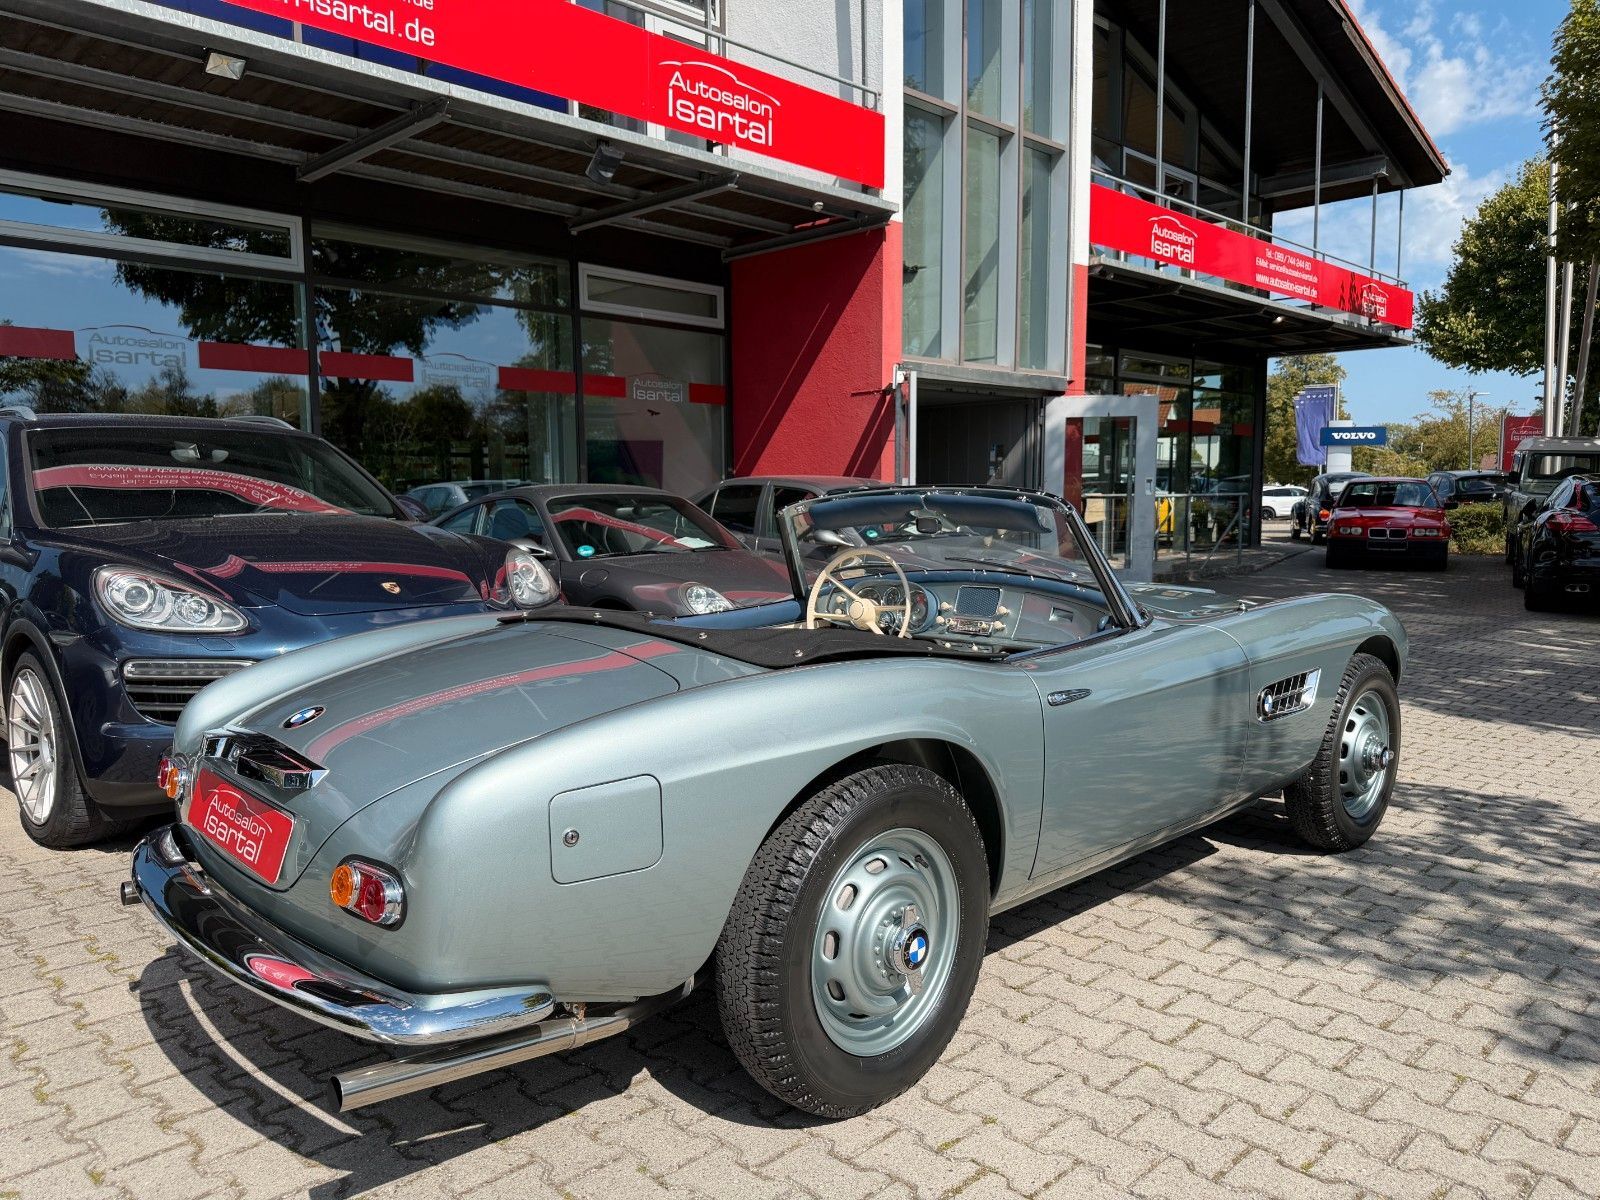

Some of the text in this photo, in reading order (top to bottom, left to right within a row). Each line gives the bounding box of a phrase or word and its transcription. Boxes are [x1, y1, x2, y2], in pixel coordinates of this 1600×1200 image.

[669, 71, 773, 119] Autosalon
[668, 87, 773, 147] Isartal
[1152, 223, 1195, 246] Autosalon
[1151, 234, 1195, 264] Isartal
[88, 344, 187, 368] Isartal
[89, 333, 186, 352] Autosalon
[633, 384, 683, 403] Isartal
[1331, 432, 1376, 440] VOLVO
[210, 794, 266, 838] Autosalon
[203, 805, 264, 865] Isartal
